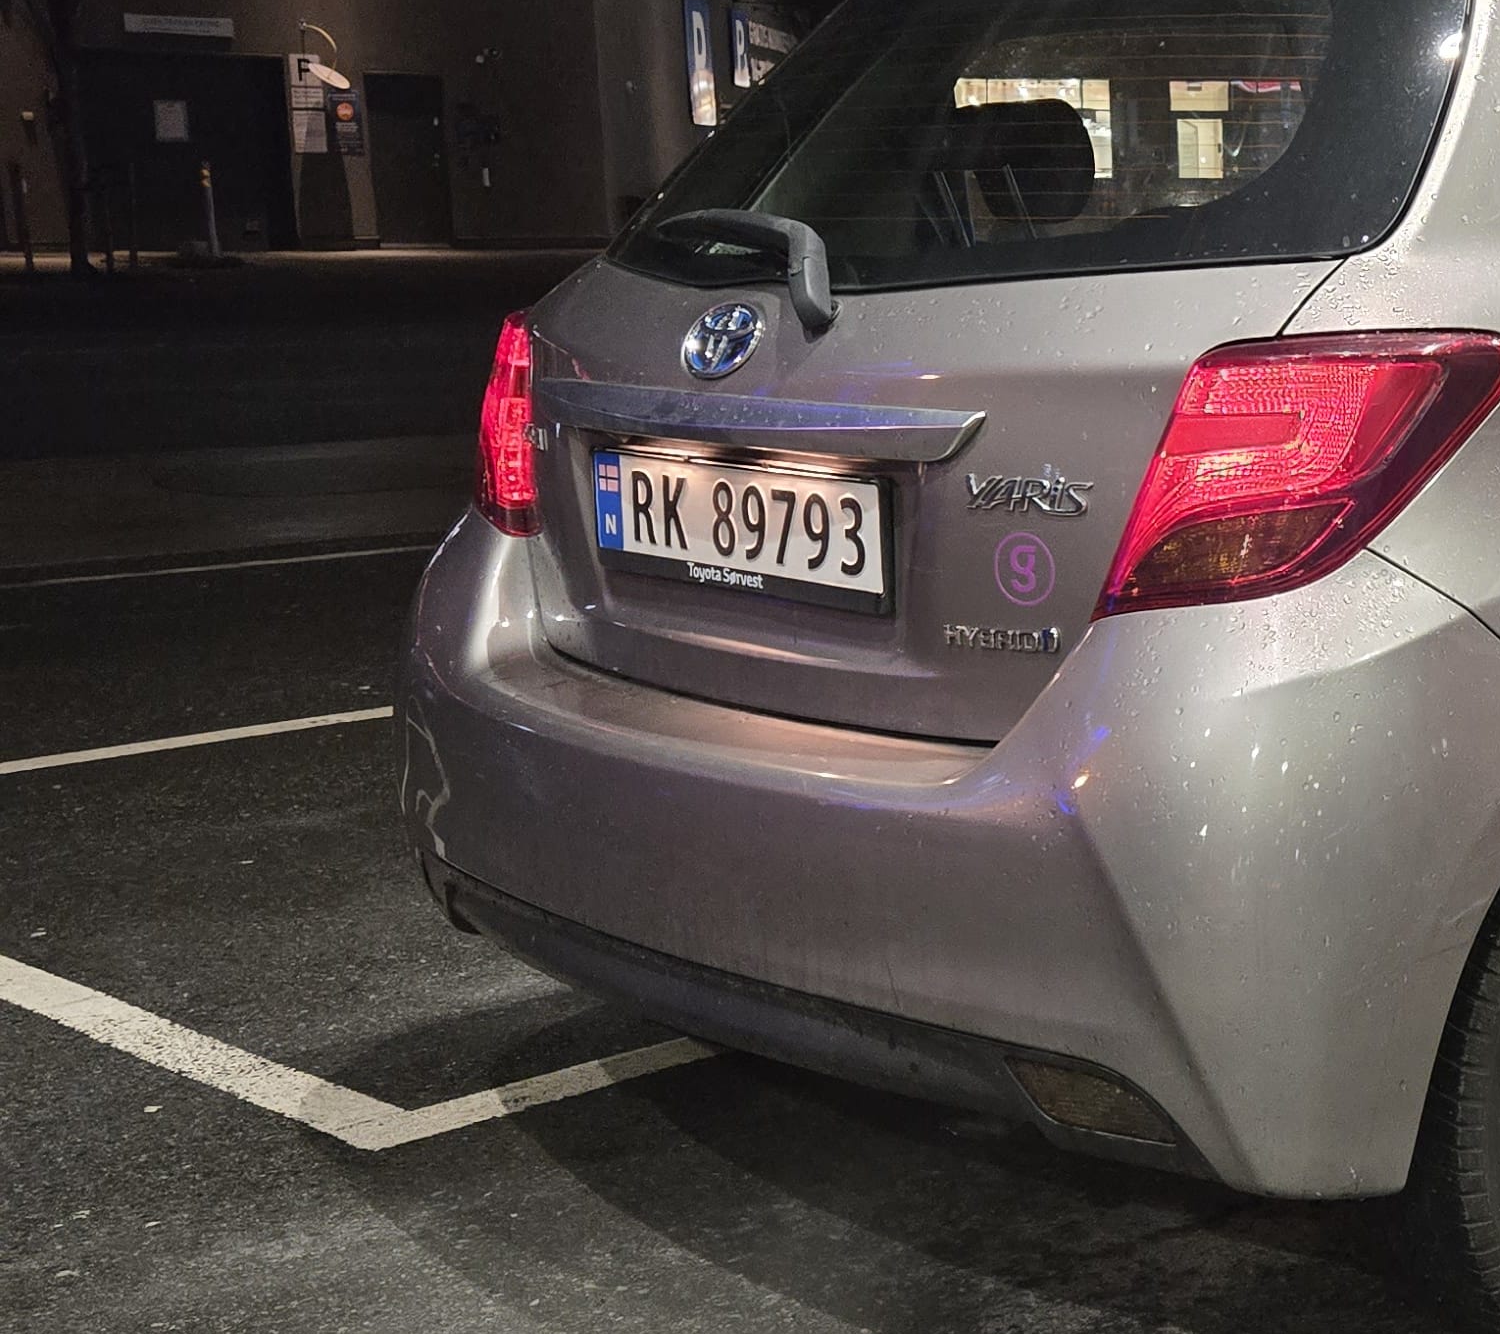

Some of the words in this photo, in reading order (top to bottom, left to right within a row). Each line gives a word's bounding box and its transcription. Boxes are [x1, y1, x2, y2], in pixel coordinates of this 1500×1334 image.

[605, 513, 617, 535] N
[631, 470, 689, 550] RK
[712, 481, 867, 577] 89793
[686, 562, 722, 583] Toyota
